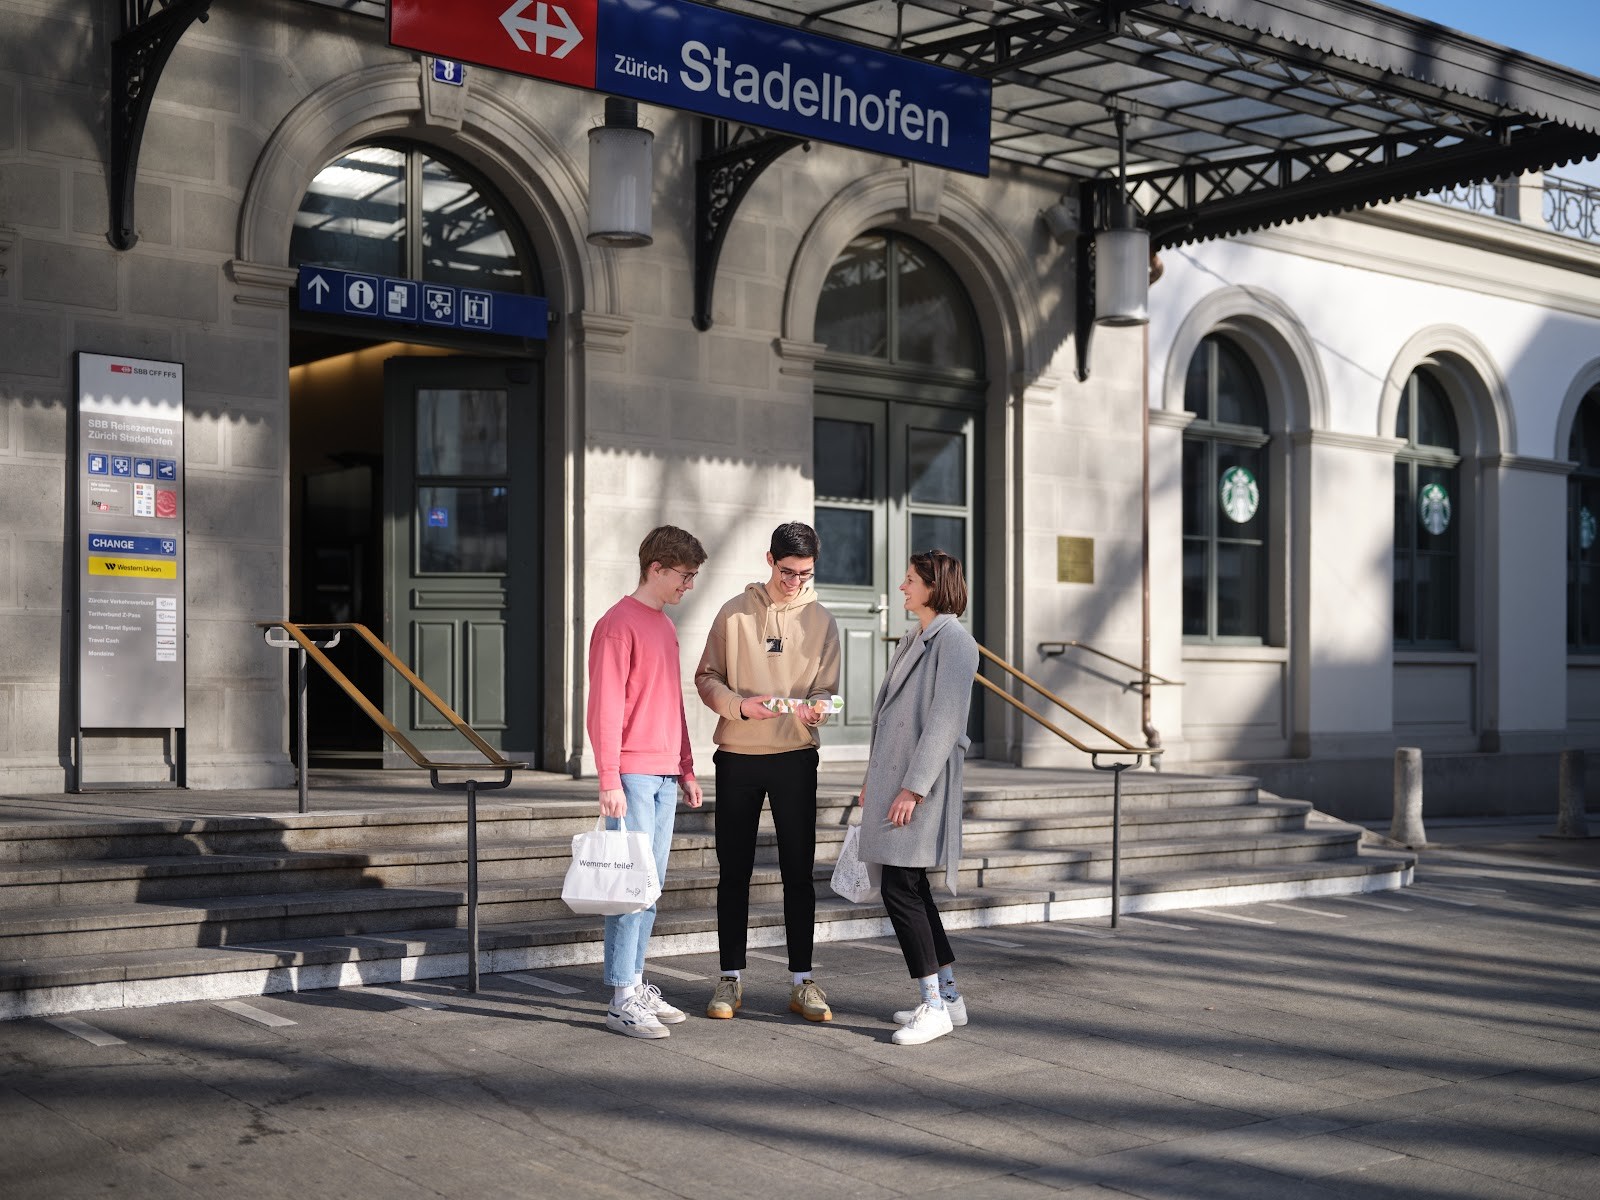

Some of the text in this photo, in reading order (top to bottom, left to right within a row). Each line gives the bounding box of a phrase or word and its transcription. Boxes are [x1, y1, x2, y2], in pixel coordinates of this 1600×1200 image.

[444, 61, 454, 80] 8
[614, 40, 949, 148] Zürich Stadelhofen
[133, 368, 177, 379] SBB CFF FFS
[88, 419, 173, 435] SBB Reisezentrum
[88, 430, 173, 446] Zürich Stadelhofen
[92, 538, 135, 549] CHANGE
[117, 564, 162, 573] Western Union
[579, 860, 634, 870] Wemmer teile?
